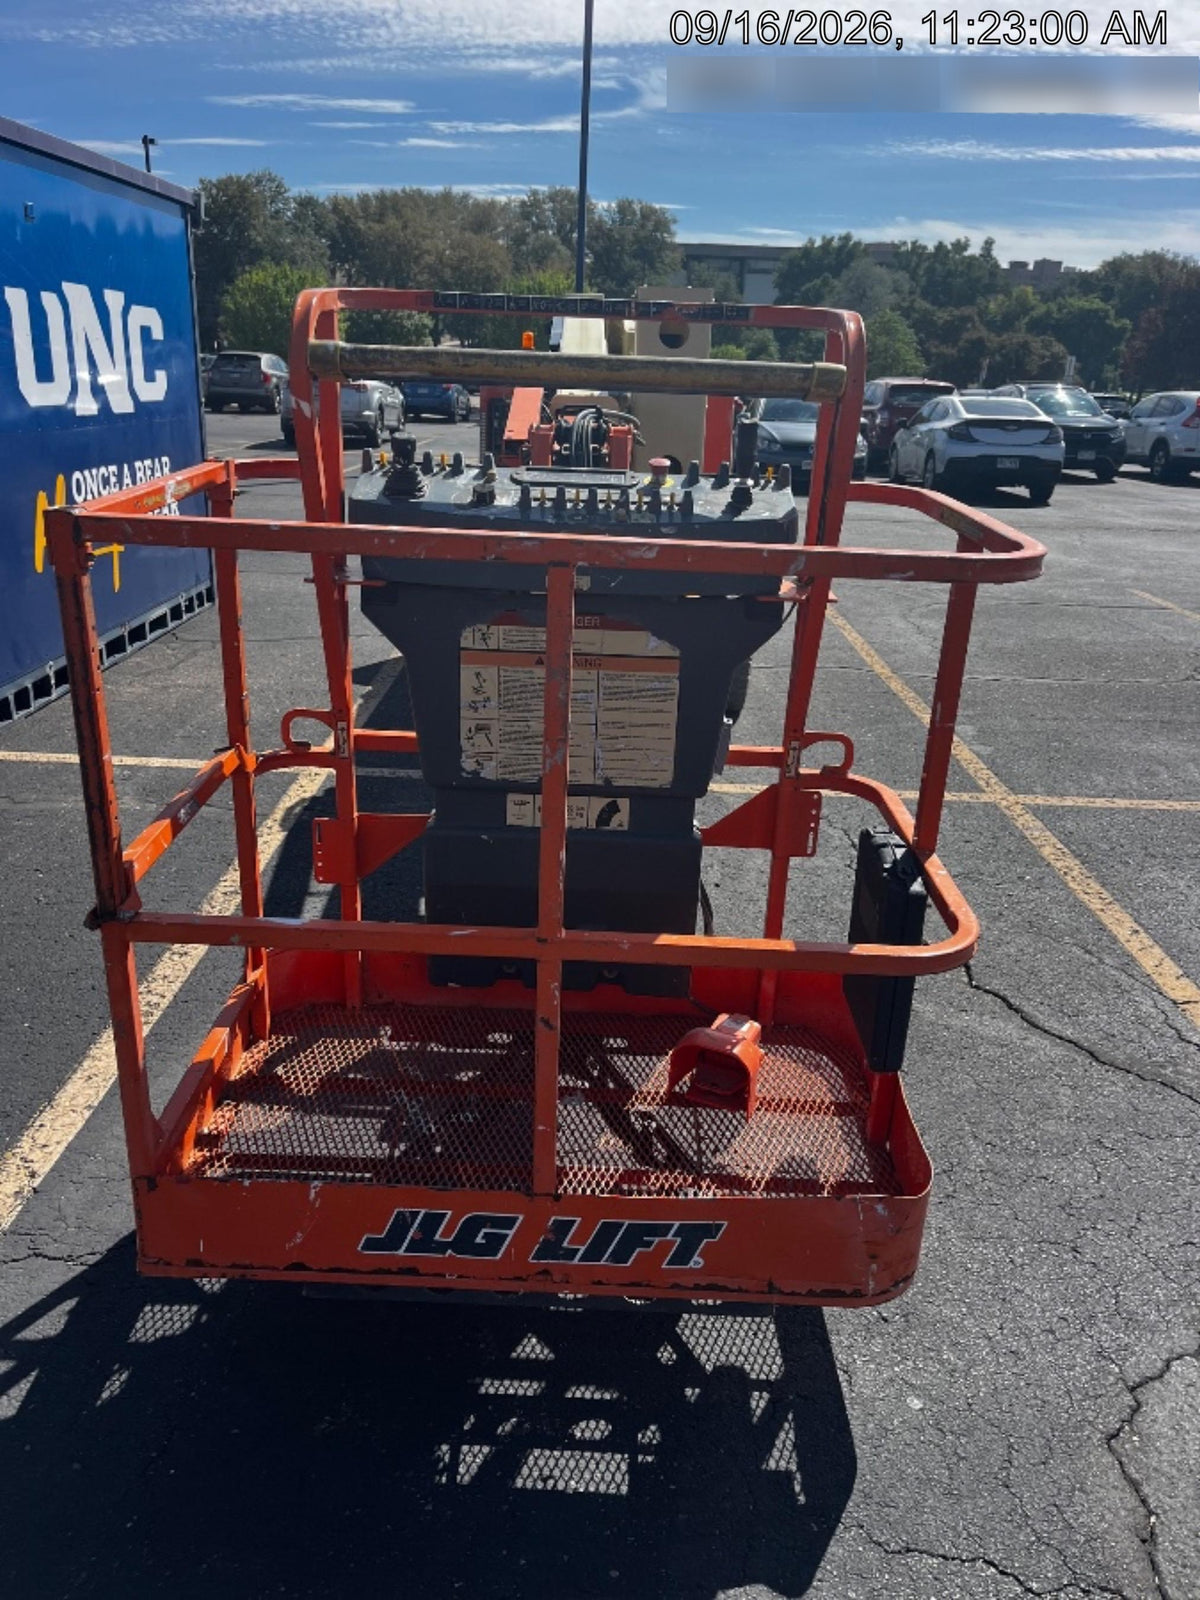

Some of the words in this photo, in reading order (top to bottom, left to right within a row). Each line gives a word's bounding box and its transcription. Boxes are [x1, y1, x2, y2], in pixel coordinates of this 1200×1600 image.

[3, 281, 168, 416] UNC
[72, 465, 119, 504] ONCE
[122, 463, 133, 490] A
[134, 456, 171, 486] BEAR
[357, 1208, 525, 1260] JLG
[528, 1216, 729, 1269] LIFT
